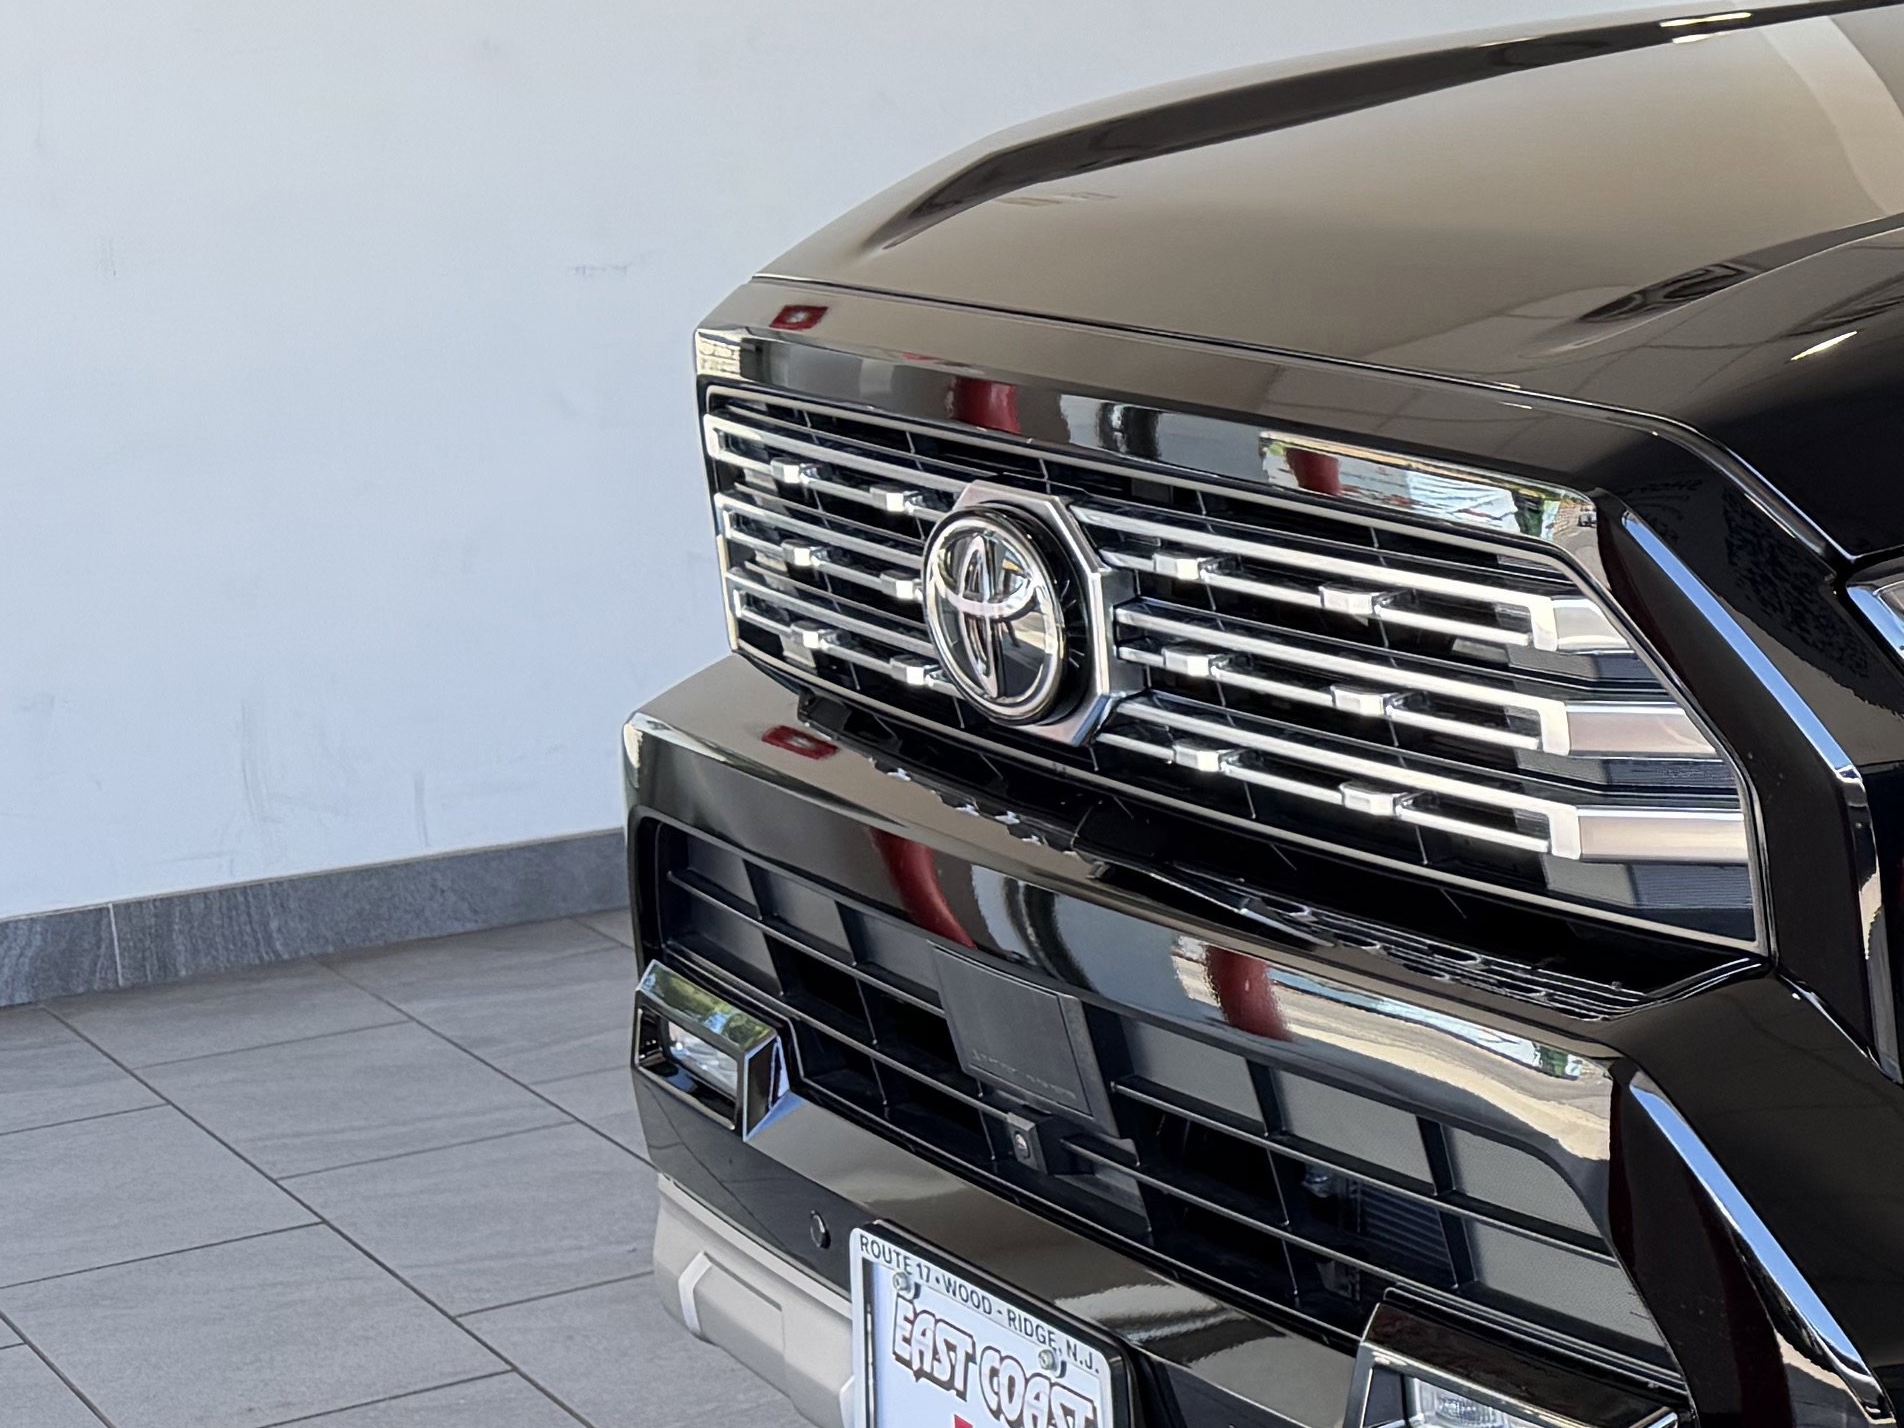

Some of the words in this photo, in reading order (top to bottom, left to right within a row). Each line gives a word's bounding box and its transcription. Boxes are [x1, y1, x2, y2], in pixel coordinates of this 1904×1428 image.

[860, 1234, 912, 1275] ROUTE
[916, 1262, 932, 1284] 17
[942, 1273, 992, 1316] WOOD
[1007, 1308, 1062, 1355] RIDGE,
[1065, 1340, 1100, 1374] N.J.
[892, 1293, 977, 1402] EAST
